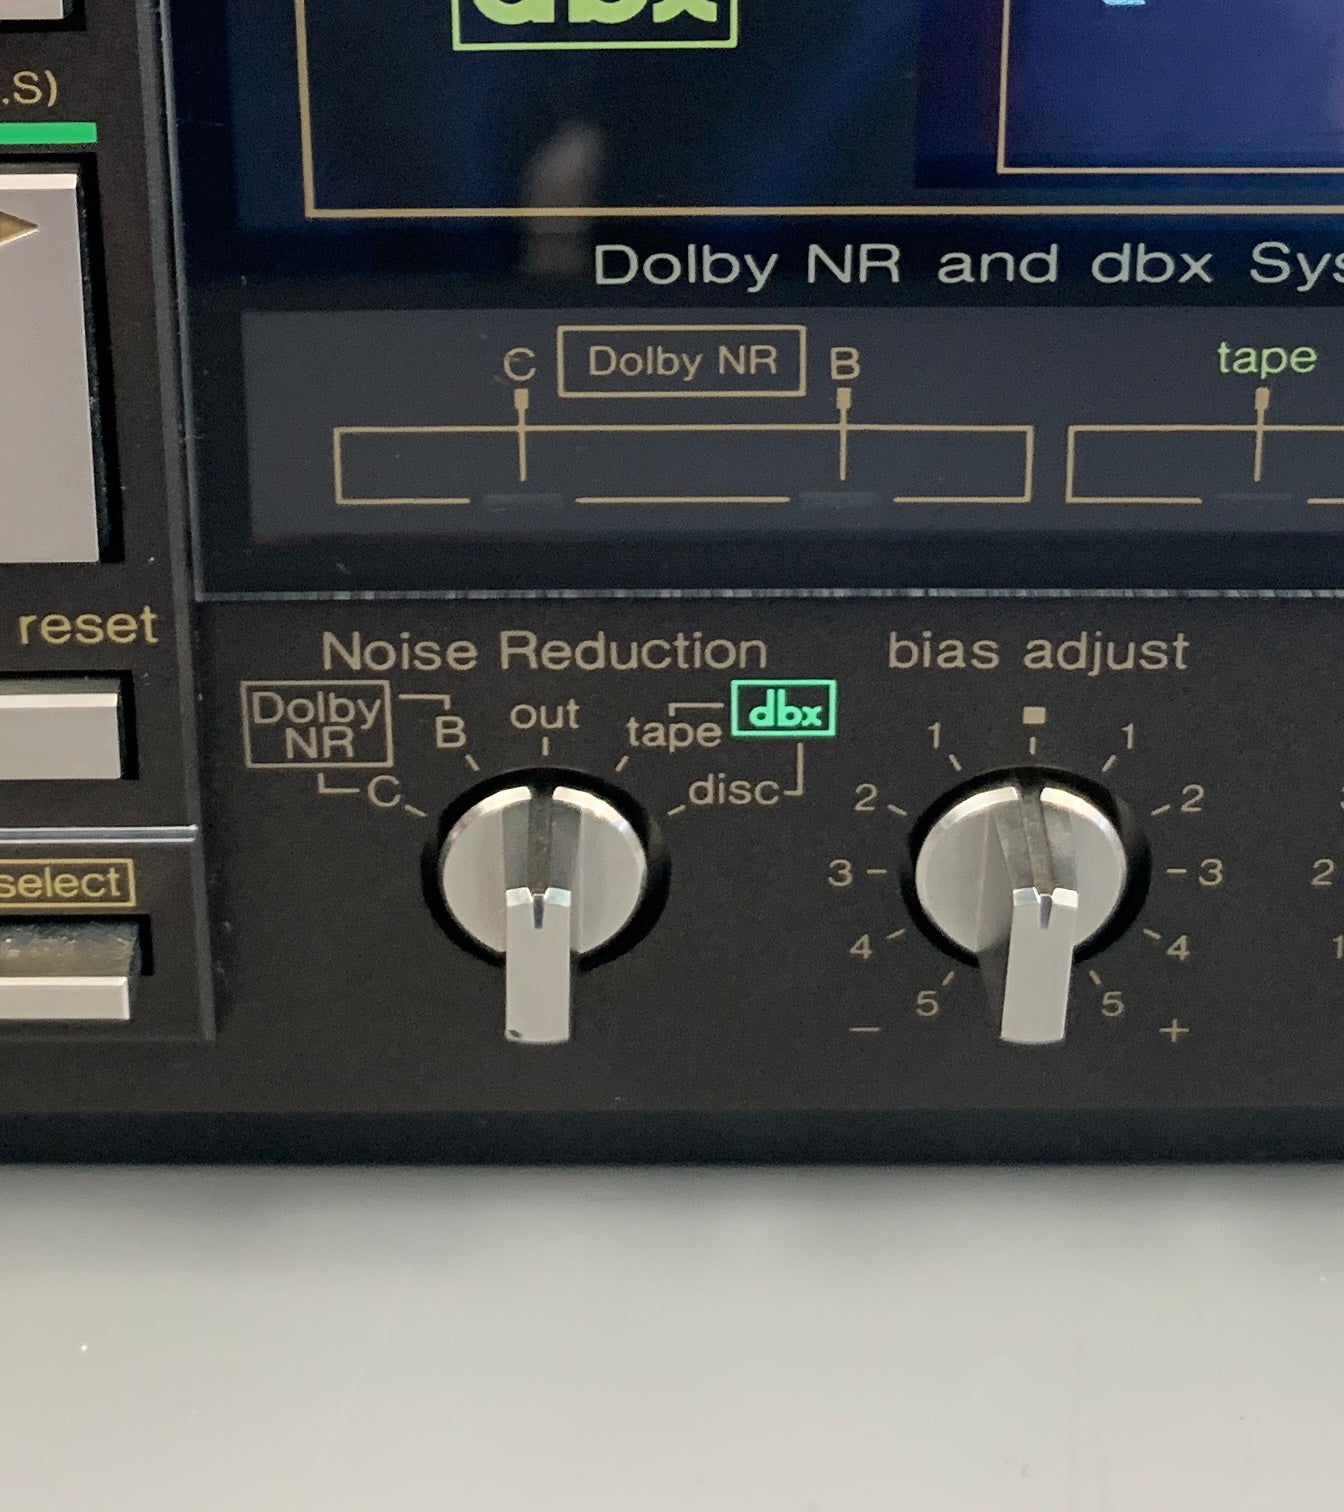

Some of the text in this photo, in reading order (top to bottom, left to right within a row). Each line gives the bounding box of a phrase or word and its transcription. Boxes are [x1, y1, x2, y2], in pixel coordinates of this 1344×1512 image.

[594, 243, 778, 292] Dolby
[807, 243, 900, 284] NR
[937, 242, 1058, 284] and
[1091, 242, 1214, 284] dbx
[504, 347, 536, 382] C
[588, 345, 777, 381] Dolby NR
[830, 348, 861, 381] B
[1216, 342, 1318, 380] tape
[17, 604, 159, 645] reset
[322, 631, 768, 671] Noise Reduction
[888, 630, 1191, 677] bias adjust
[253, 691, 382, 729] Dolby
[509, 700, 580, 730] out
[748, 688, 823, 728] dbx
[286, 727, 354, 760] NR
[437, 716, 467, 748] B
[626, 717, 723, 752] tape
[928, 722, 941, 749] 1
[1122, 722, 1136, 749] 1
[368, 775, 402, 809] C
[688, 773, 780, 806] disc
[854, 784, 880, 813] 2
[1181, 784, 1205, 813] 2
[827, 859, 854, 888] 3
[1198, 858, 1224, 887] 3
[1312, 859, 1335, 887] 2
[849, 933, 873, 960] 4
[1166, 934, 1191, 962] 4
[915, 991, 940, 1018] 5
[1101, 991, 1125, 1018] 5
